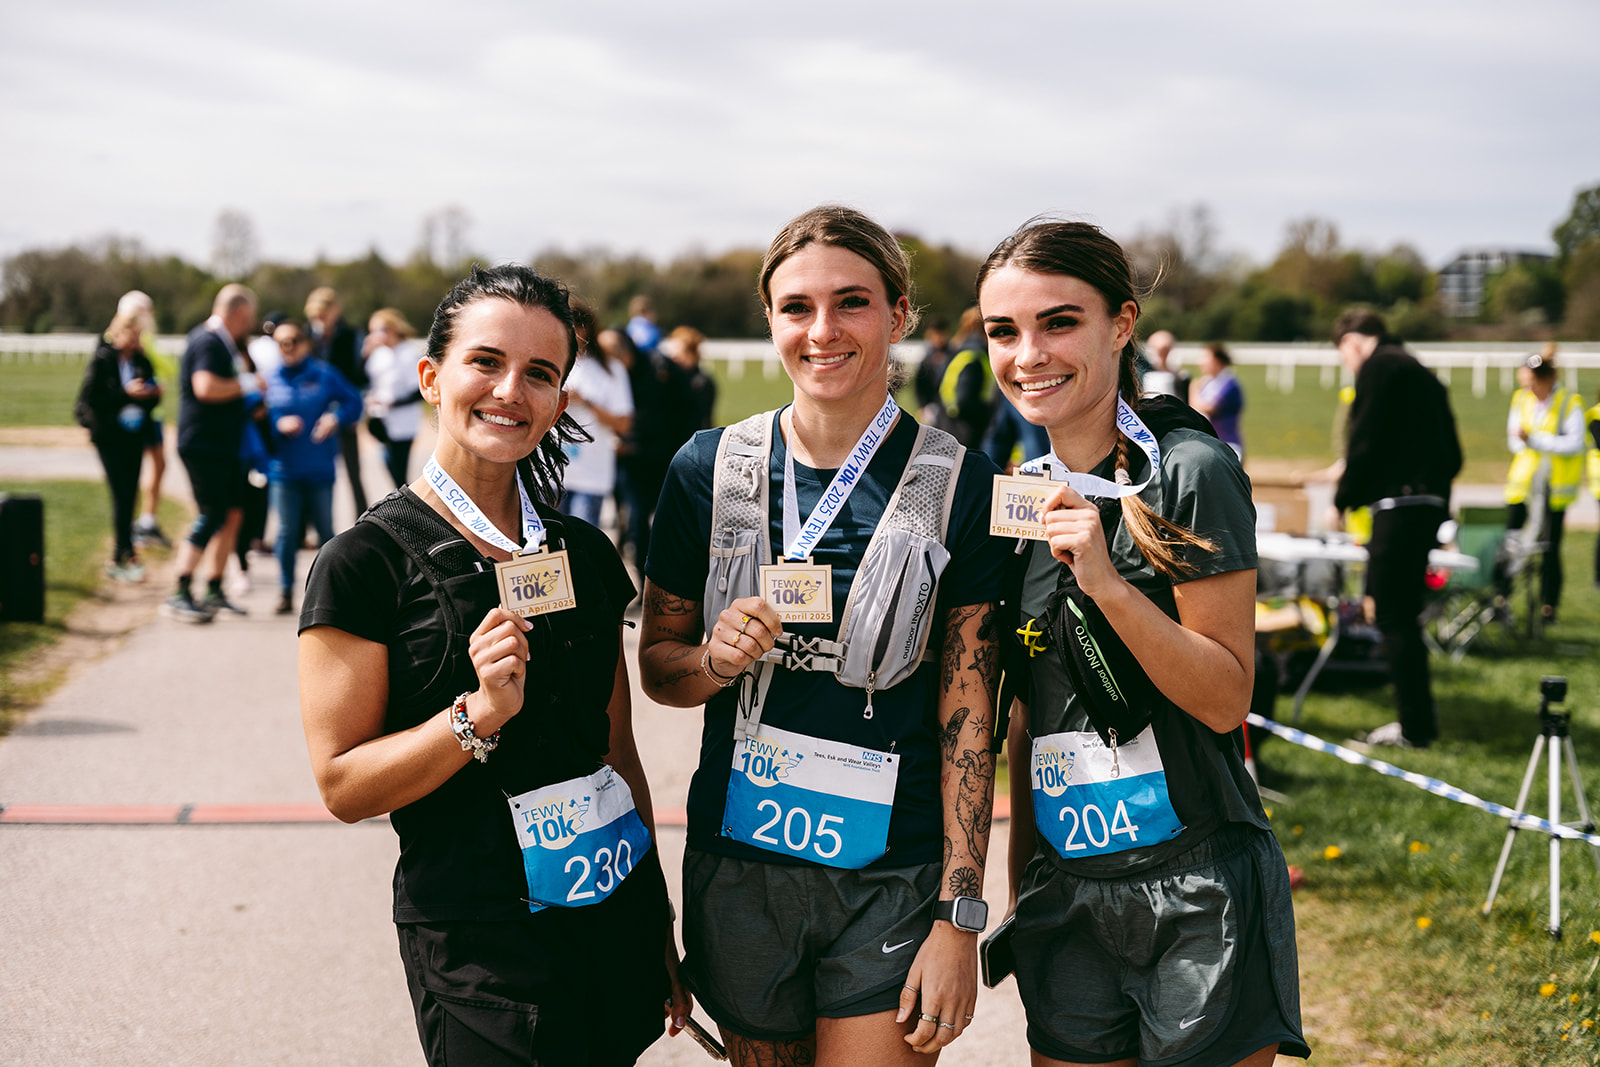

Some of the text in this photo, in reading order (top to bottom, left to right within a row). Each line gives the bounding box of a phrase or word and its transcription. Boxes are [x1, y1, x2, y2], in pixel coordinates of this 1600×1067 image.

[877, 399, 897, 432] 2025
[853, 430, 881, 467] TEWV
[446, 488, 475, 518] 2025
[819, 485, 845, 516] 2025
[1006, 493, 1037, 505] TEWV
[1005, 504, 1040, 522] 10k
[797, 517, 827, 550] TEWV
[992, 526, 1012, 535] 19th
[1015, 528, 1037, 537] April
[510, 572, 540, 586] TEWV
[771, 579, 802, 588] TEWV
[512, 582, 548, 601] 10k
[772, 588, 806, 604] 10k
[528, 603, 551, 614] April
[553, 599, 575, 609] 2025
[785, 612, 808, 621] April
[810, 612, 831, 620] 2025
[903, 582, 930, 659] outdoor INOXTO
[1075, 625, 1119, 701] outdoor INOXTO
[745, 738, 779, 758] TEWV
[862, 751, 882, 762] NHS
[1035, 752, 1058, 766] TEWV
[741, 752, 781, 781] 10k
[1036, 764, 1068, 789] 10k
[521, 802, 564, 823] TEWV
[526, 815, 578, 845] 10k
[752, 799, 844, 859] 205
[1058, 799, 1139, 851] 204
[564, 839, 632, 902] 230
